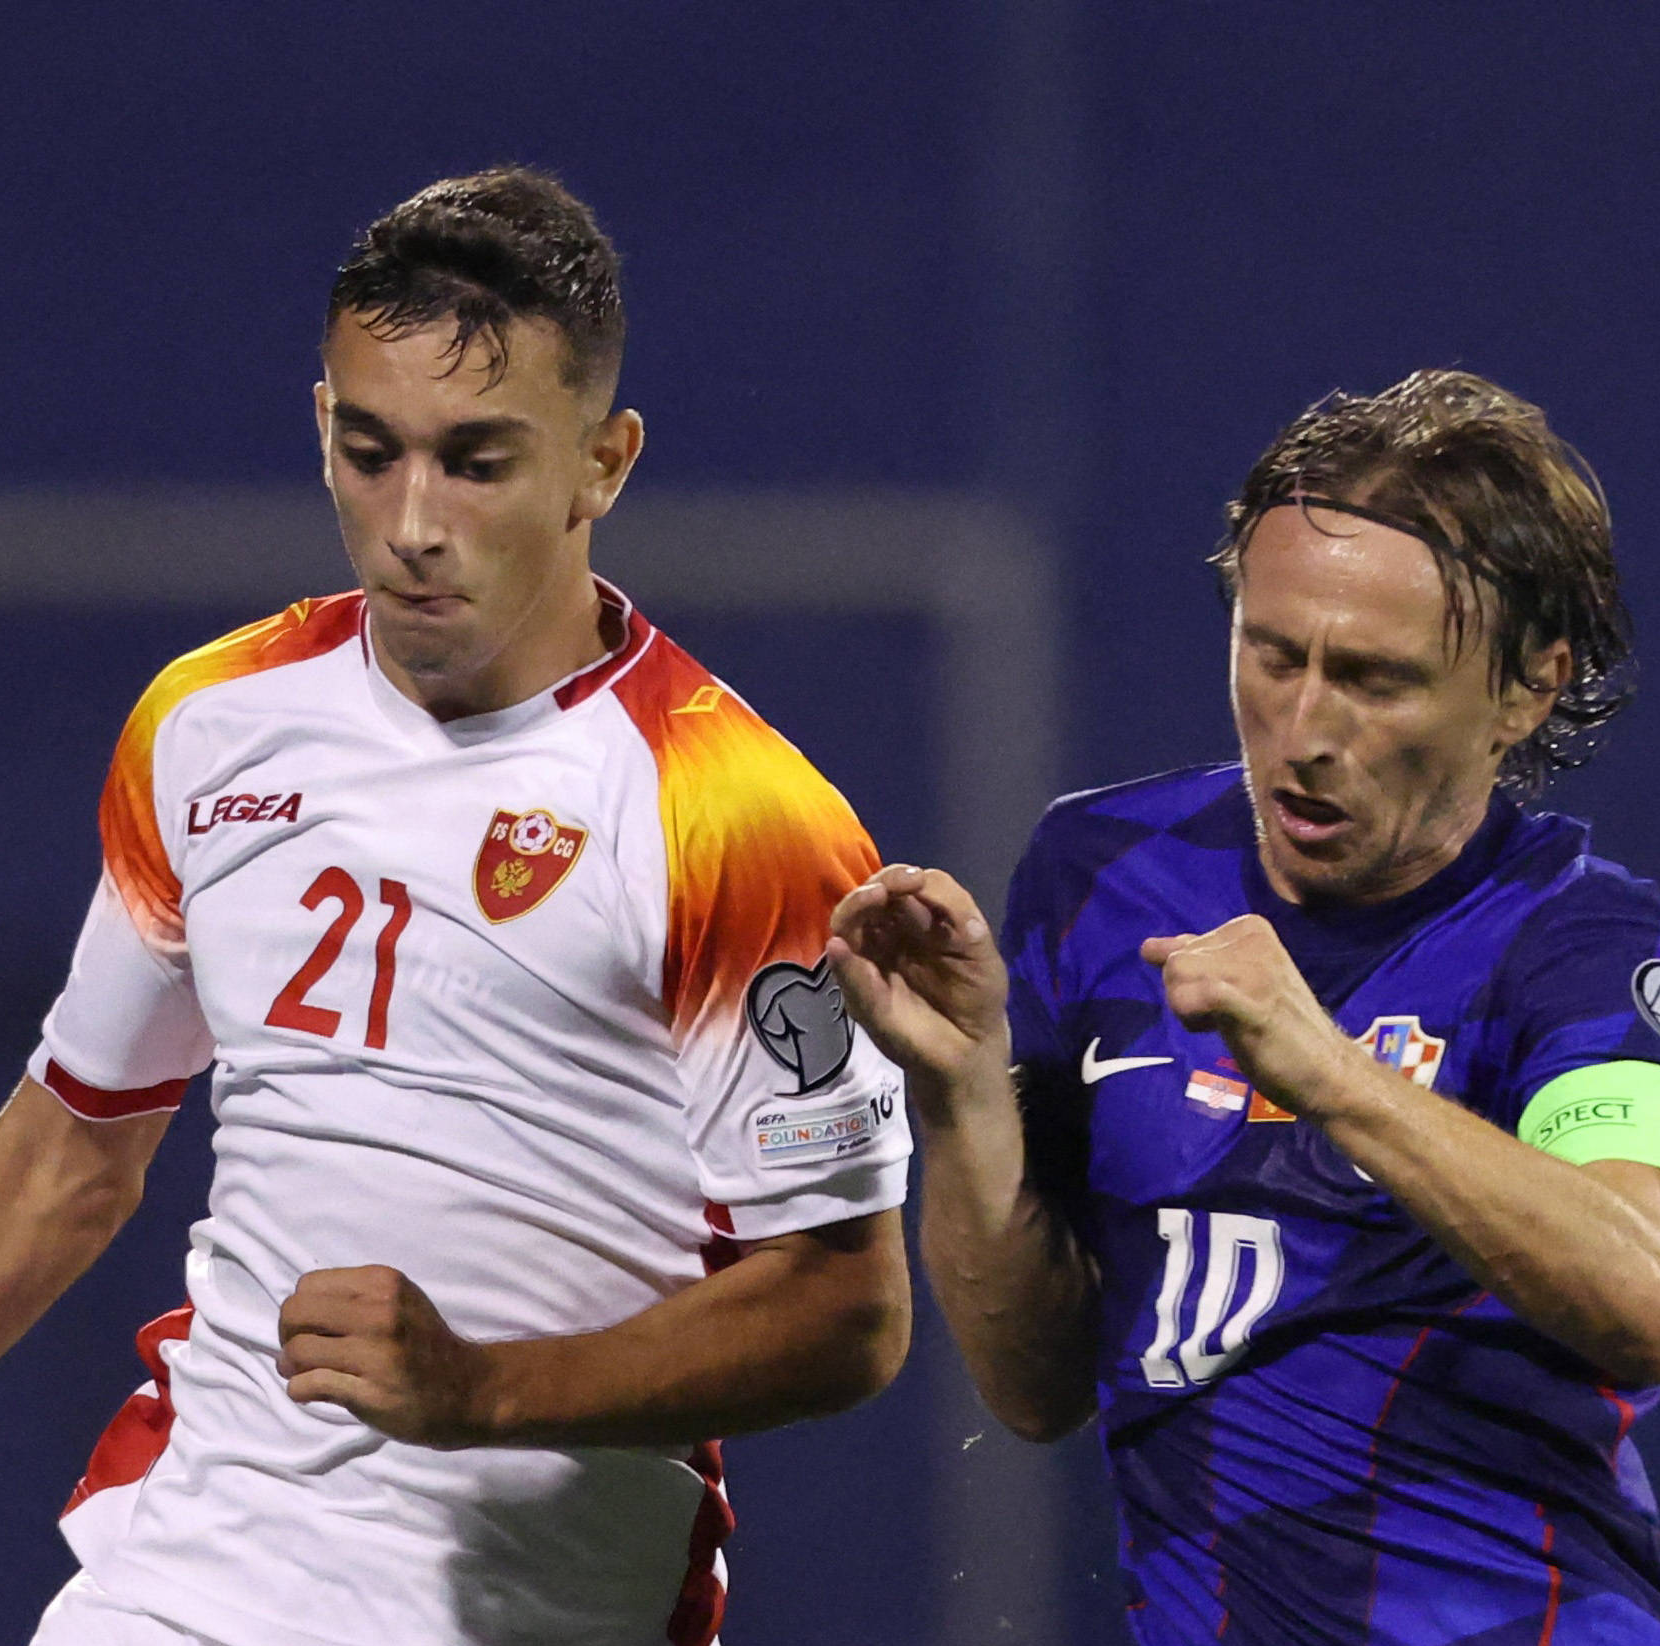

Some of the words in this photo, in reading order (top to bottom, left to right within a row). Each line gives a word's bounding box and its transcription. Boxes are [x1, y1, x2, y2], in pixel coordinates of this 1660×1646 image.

[188, 792, 303, 836] LEGEA
[553, 837, 576, 859] CG
[264, 866, 413, 1050] 21
[756, 1113, 786, 1127] UEFA
[758, 1115, 870, 1147] FOUNDATION
[1140, 1207, 1286, 1388] 10
